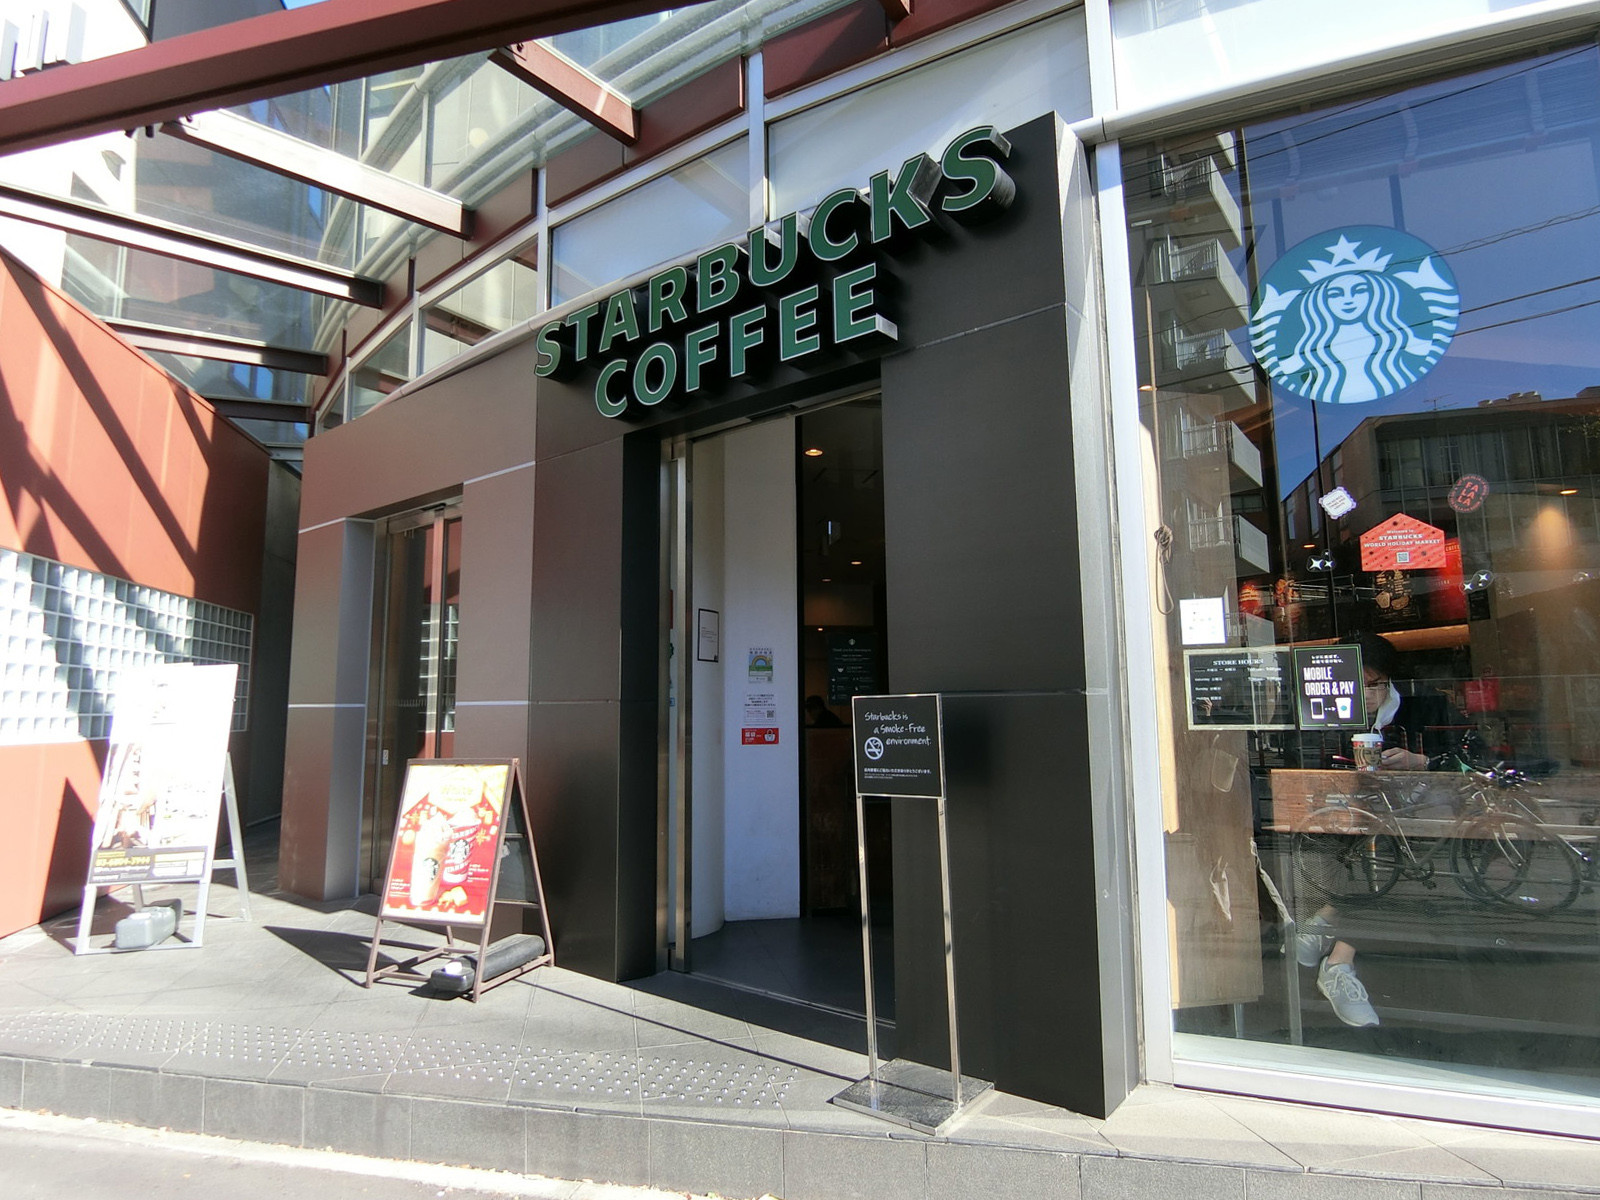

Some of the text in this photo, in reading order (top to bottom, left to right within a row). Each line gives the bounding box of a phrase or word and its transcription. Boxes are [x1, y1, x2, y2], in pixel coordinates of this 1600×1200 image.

[534, 124, 1008, 378] STARBUCKS
[594, 262, 880, 418] COFFEE
[1465, 481, 1479, 492] FA
[1461, 488, 1475, 499] LA
[1457, 495, 1471, 506] LA
[1303, 666, 1333, 681] MOBILE
[1304, 680, 1354, 696] ORDER & PAY
[865, 711, 909, 721] Starbucks is
